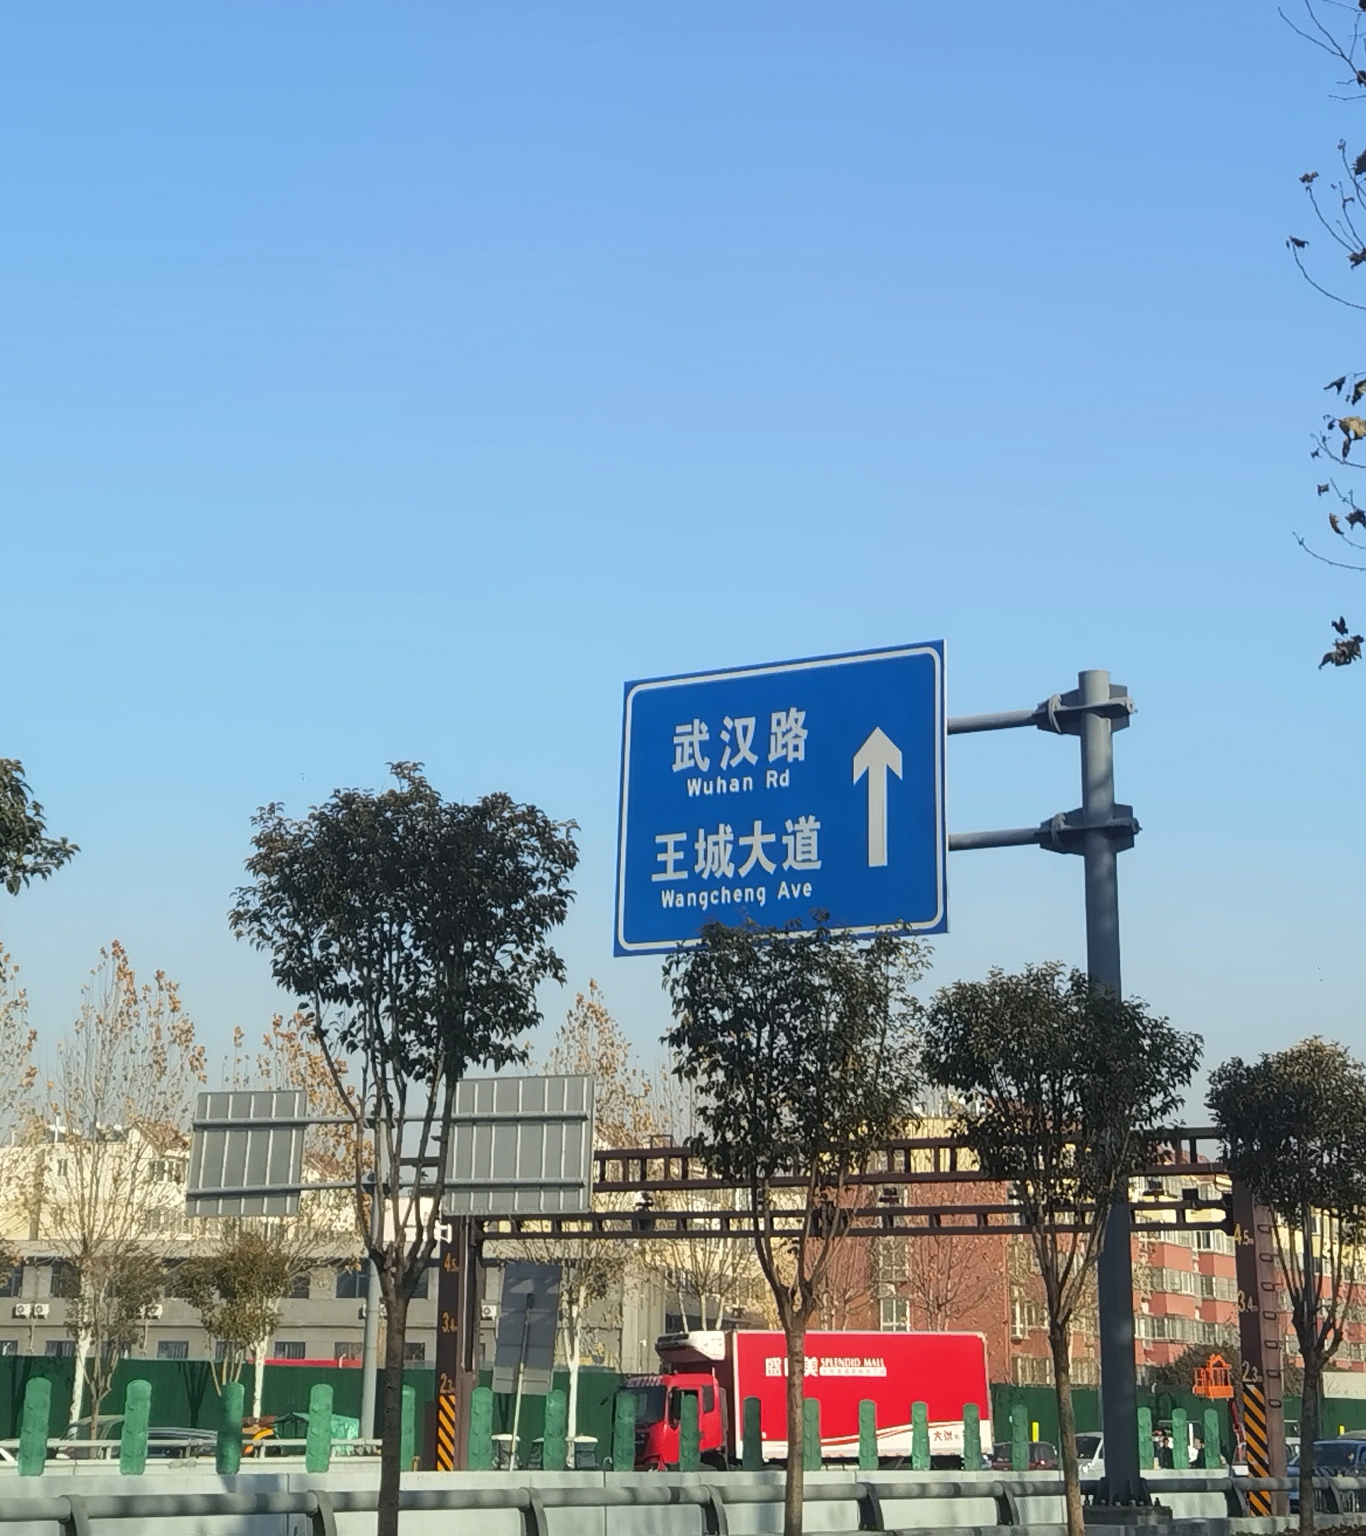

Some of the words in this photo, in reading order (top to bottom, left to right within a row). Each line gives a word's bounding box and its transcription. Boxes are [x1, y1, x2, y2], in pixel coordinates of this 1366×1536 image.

[672, 706, 809, 773] 武汉路
[686, 773, 754, 798] Wuhan
[765, 768, 791, 790] Rd
[651, 814, 823, 884] 王城大道
[661, 884, 767, 911] Wangcheng
[777, 880, 813, 900] Ave
[765, 1356, 819, 1378] 盛美
